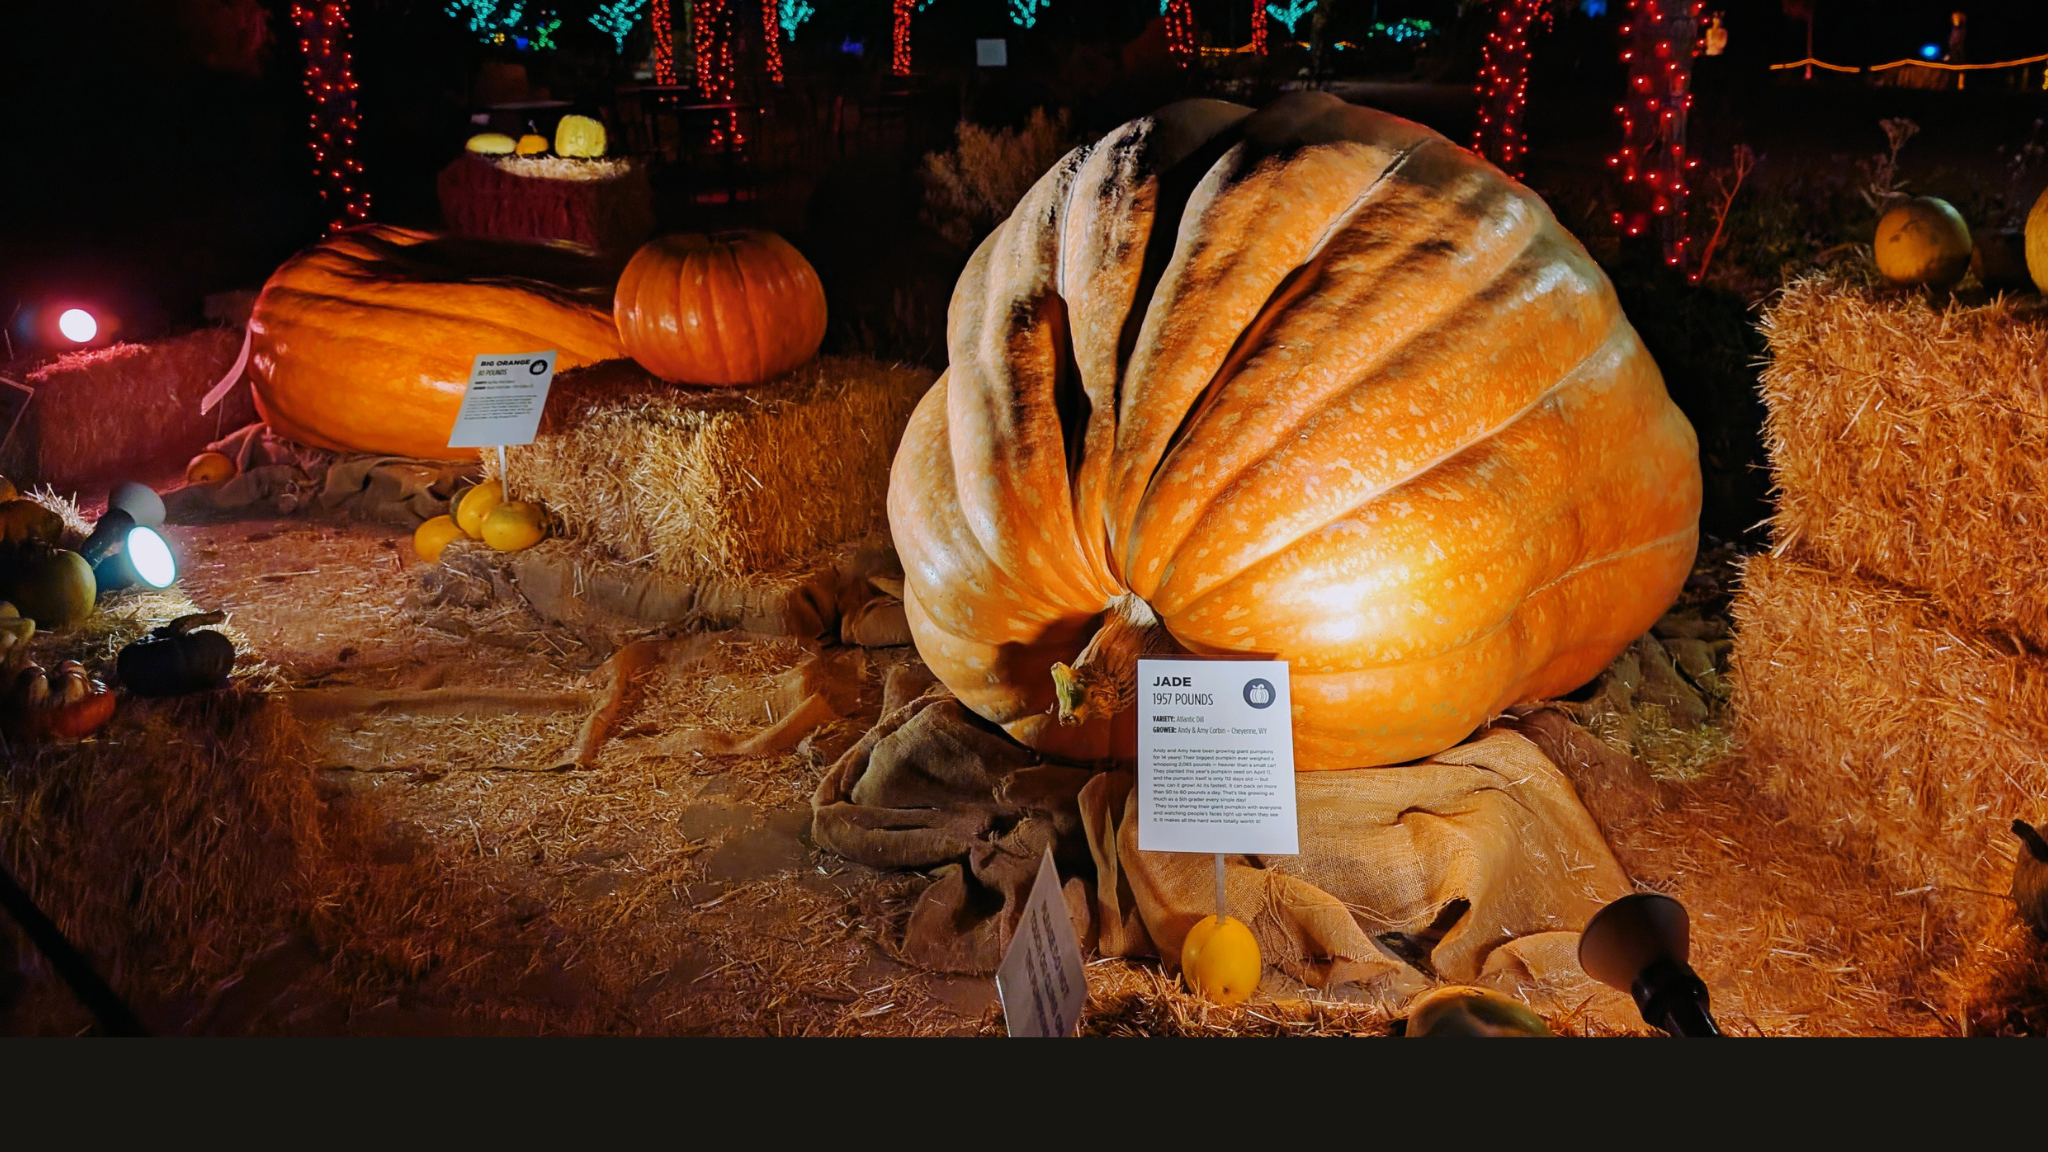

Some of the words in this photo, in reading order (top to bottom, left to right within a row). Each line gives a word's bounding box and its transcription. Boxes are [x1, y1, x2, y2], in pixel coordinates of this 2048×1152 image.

[1153, 676, 1192, 687] JADE
[1153, 693, 1172, 705] 1957
[1175, 693, 1214, 706] POUNDS
[1153, 726, 1177, 734] GROWER:
[1178, 727, 1191, 735] Andy
[1197, 727, 1208, 735] Amy
